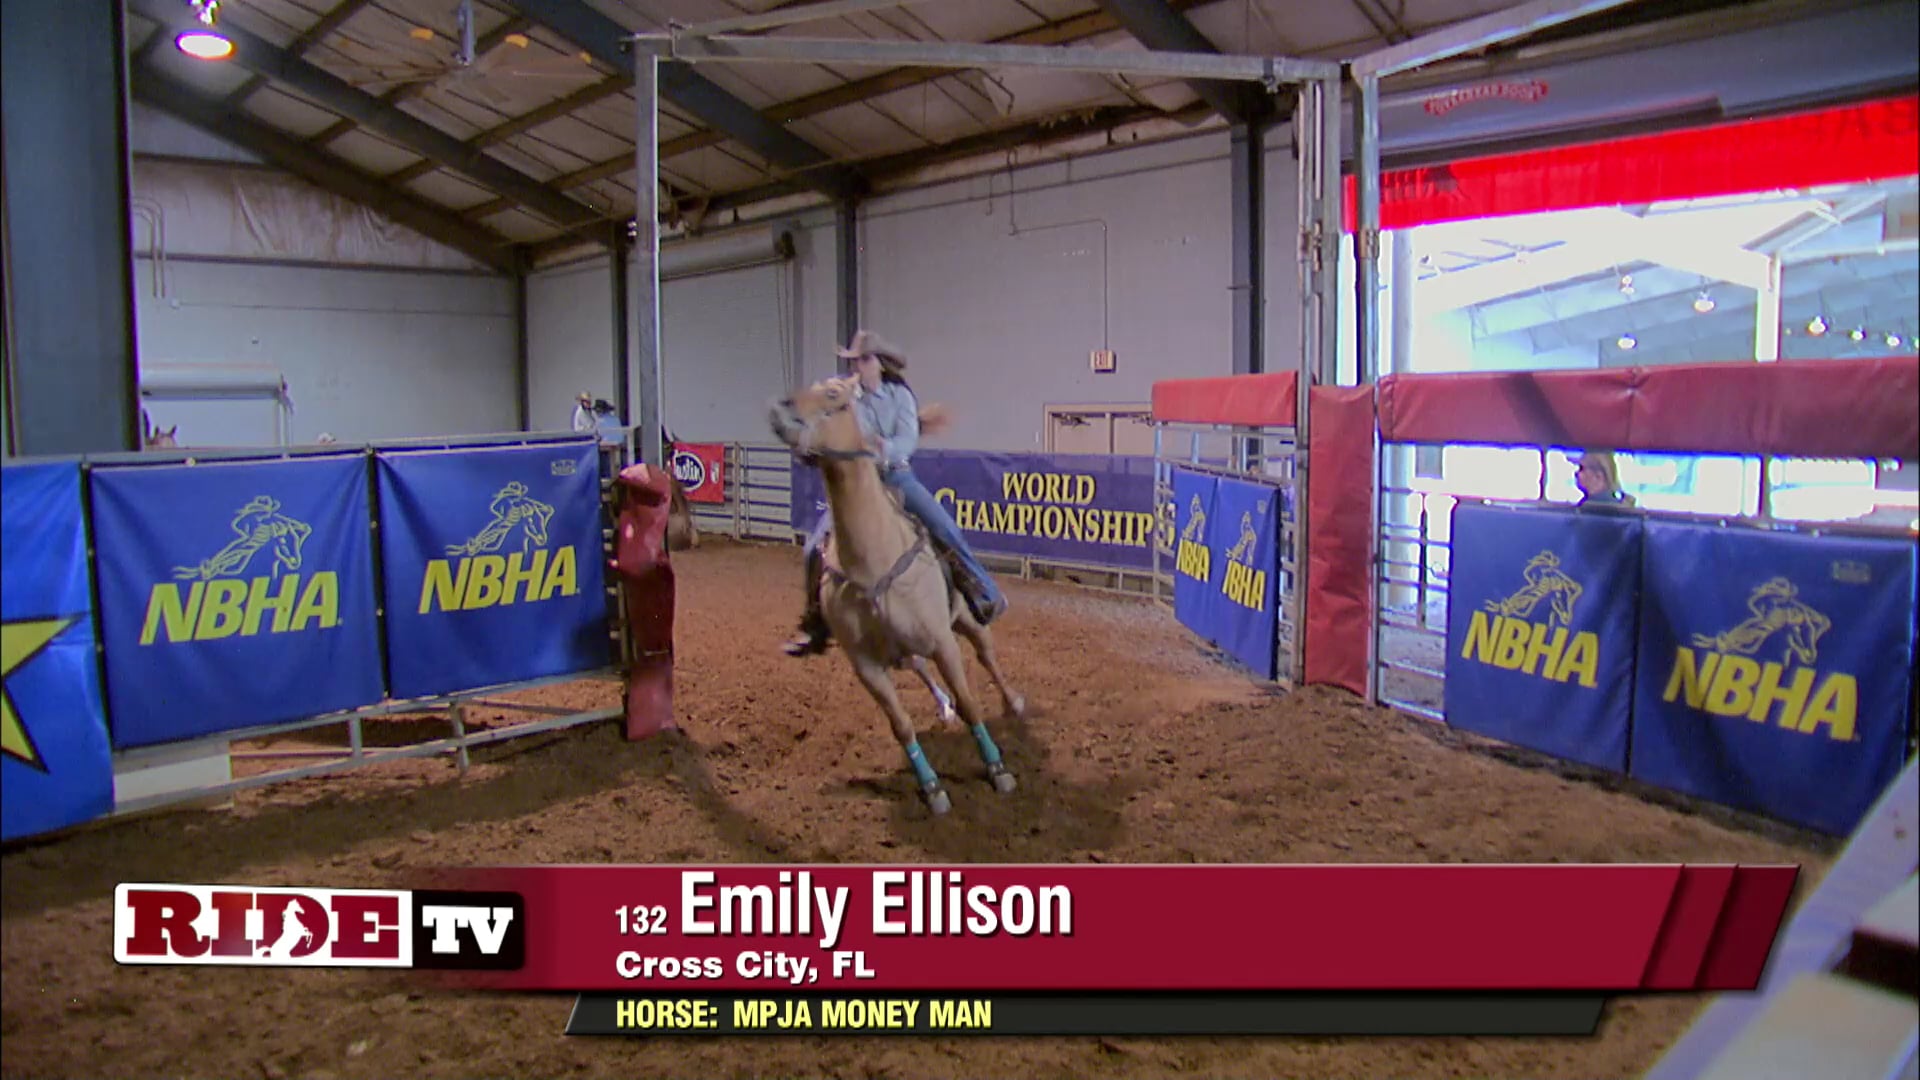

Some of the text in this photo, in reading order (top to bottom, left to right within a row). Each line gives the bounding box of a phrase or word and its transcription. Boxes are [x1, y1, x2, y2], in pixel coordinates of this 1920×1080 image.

[1002, 472, 1096, 506] WORLD
[140, 571, 339, 645] NBHA
[418, 546, 577, 614] NBHA
[1462, 610, 1598, 688] NBHA
[1664, 646, 1858, 741] NBHA
